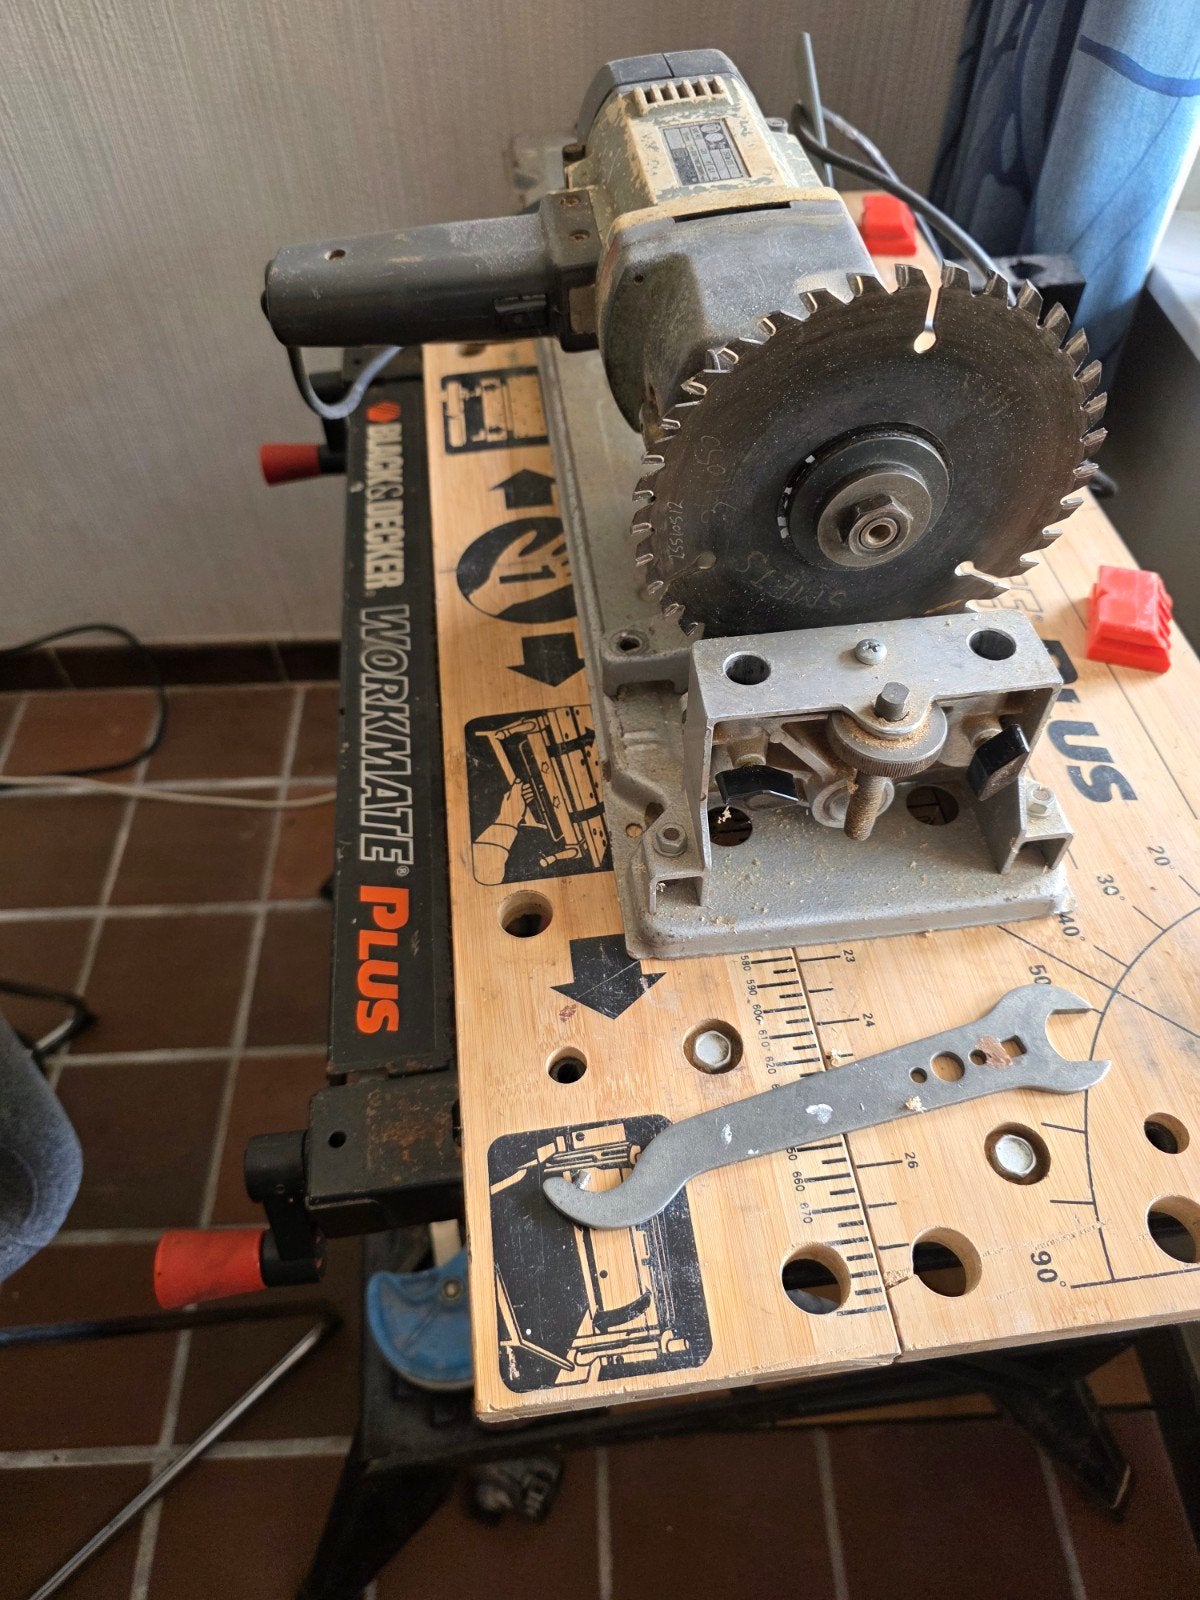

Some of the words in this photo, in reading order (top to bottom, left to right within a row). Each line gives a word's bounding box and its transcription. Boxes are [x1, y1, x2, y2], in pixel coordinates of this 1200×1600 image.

[1044, 639, 1138, 803] PUS
[356, 885, 409, 1034] PLUS
[740, 955, 751, 971] 580
[842, 949, 855, 963] 23
[746, 979, 758, 996] 590
[752, 1004, 763, 1021] 600
[862, 1013, 875, 1027] 24
[758, 1029, 770, 1047] 610
[766, 1056, 777, 1074] 620
[786, 1147, 797, 1161] 50
[904, 1151, 918, 1169] 26
[792, 1171, 805, 1192] 660
[799, 1202, 813, 1224] 670
